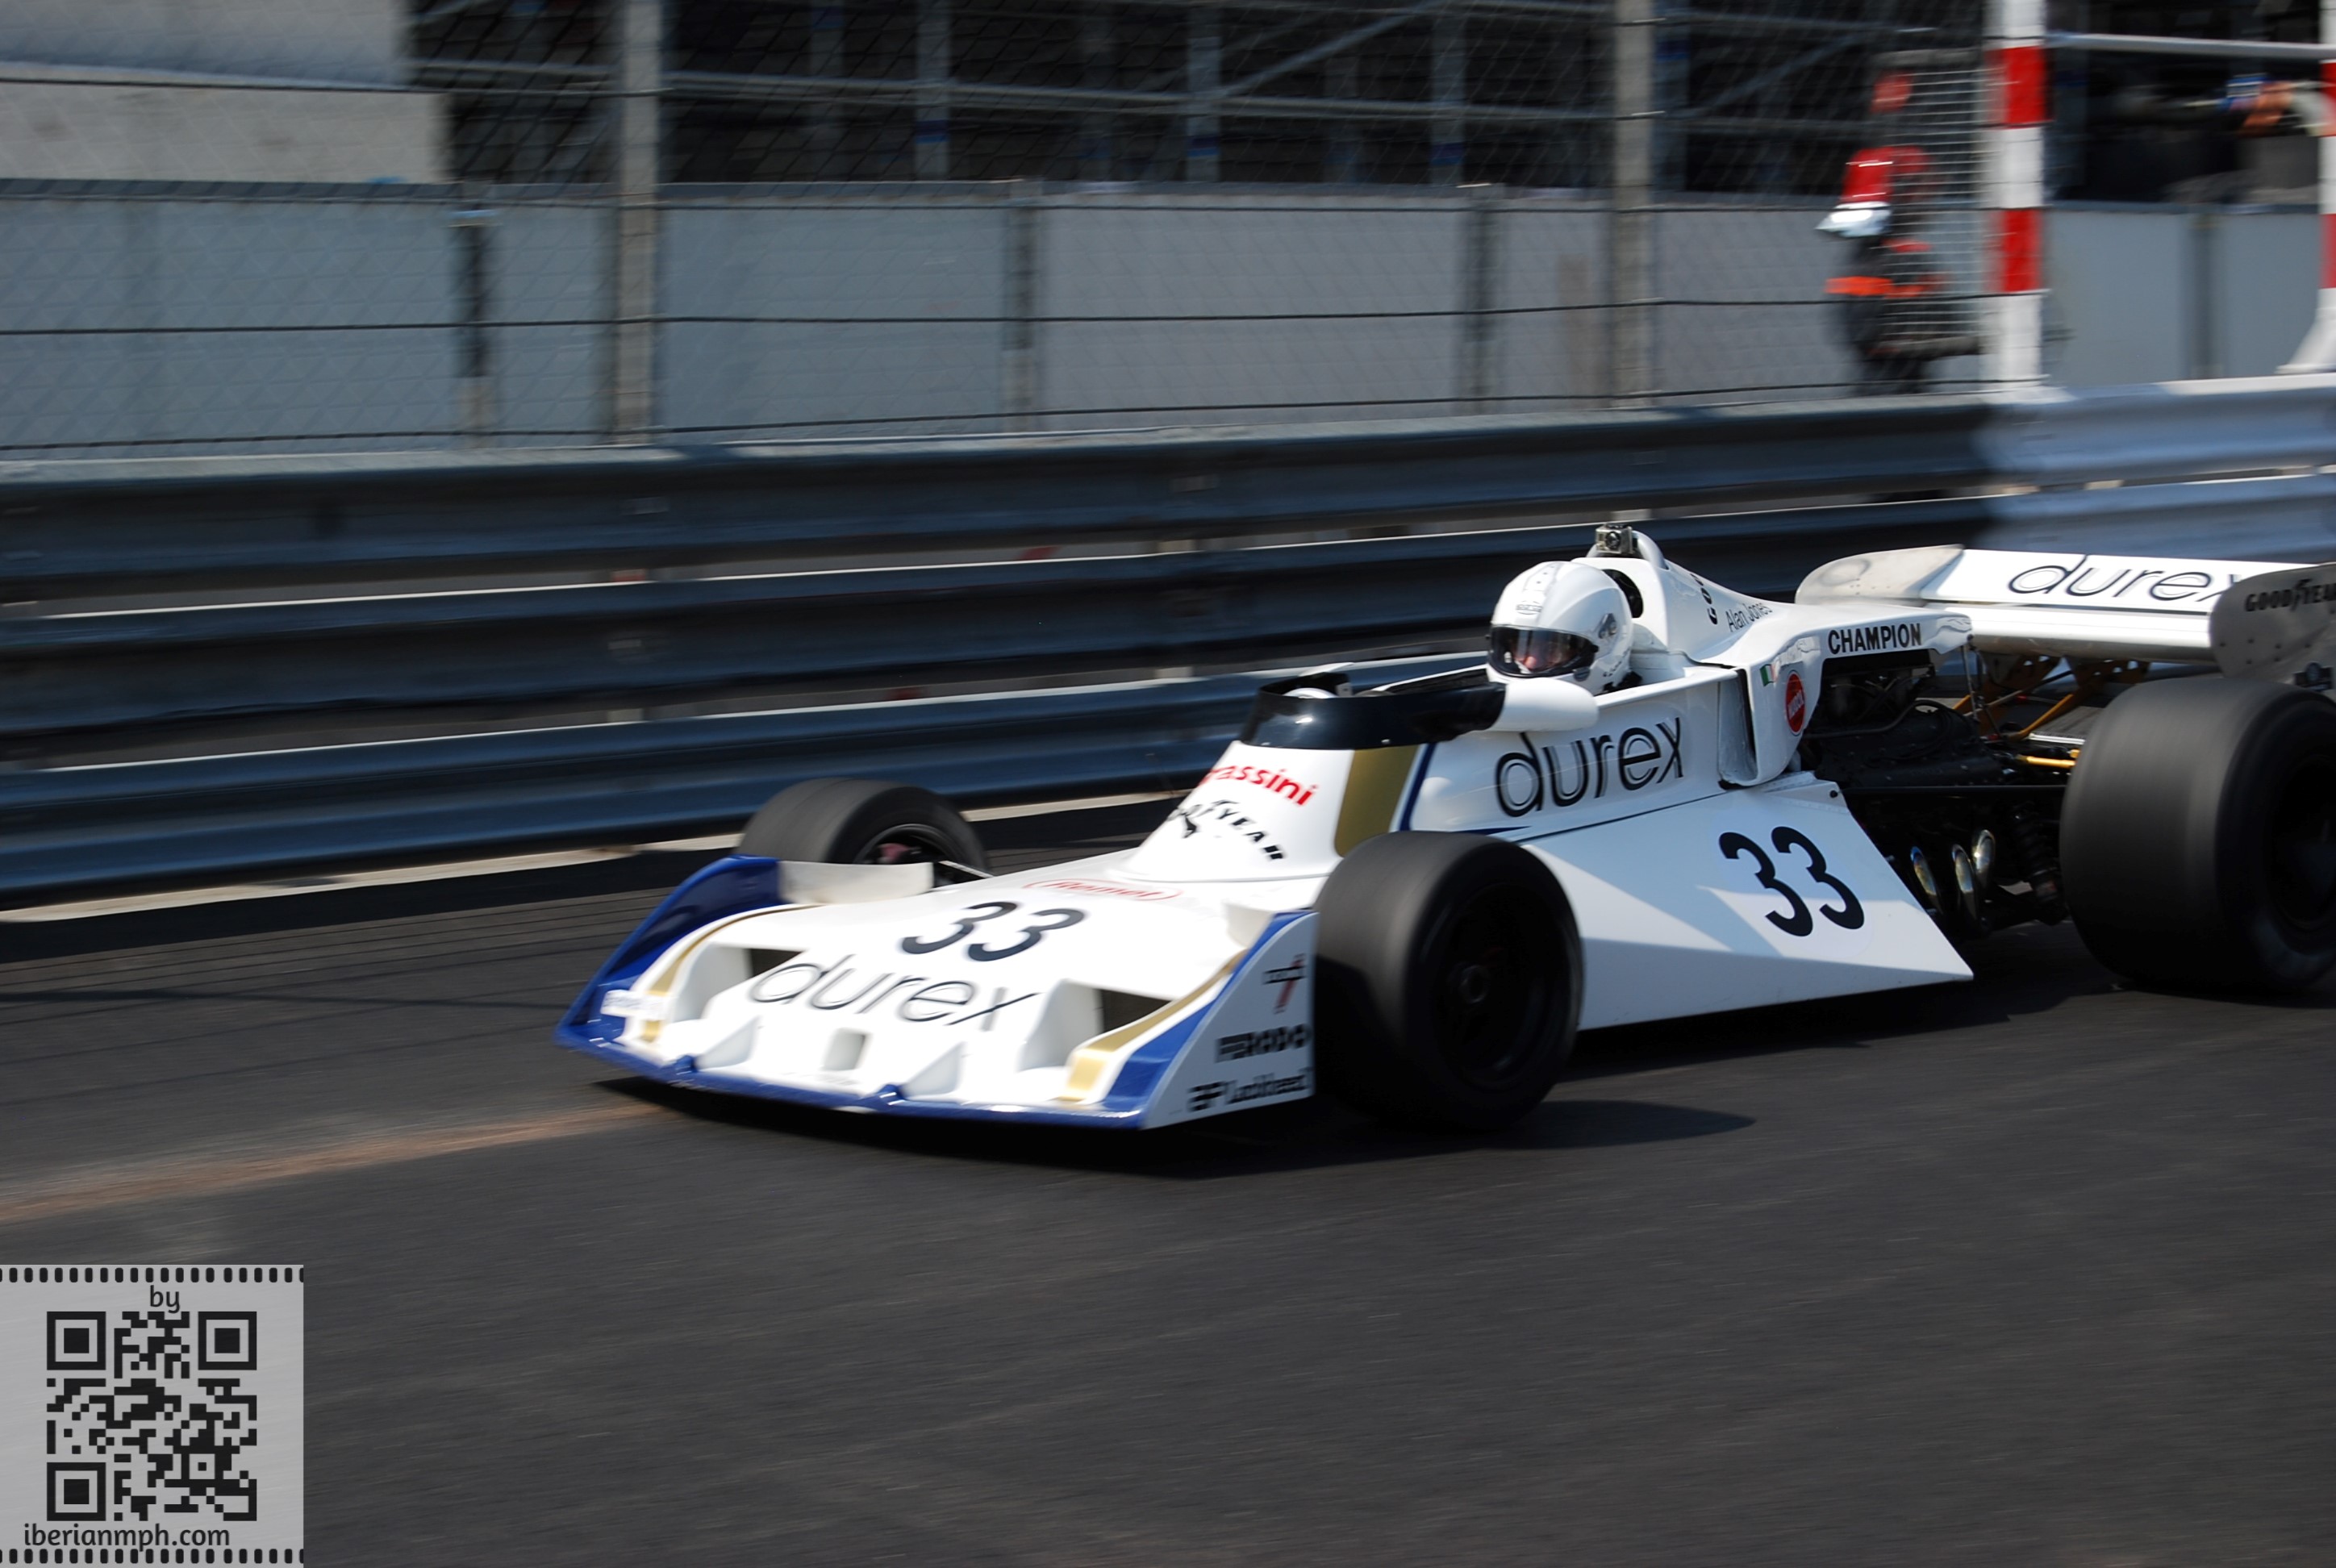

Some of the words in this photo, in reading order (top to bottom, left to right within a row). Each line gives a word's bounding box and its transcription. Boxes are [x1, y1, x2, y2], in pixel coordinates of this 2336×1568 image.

[1725, 608, 1750, 633] Alan
[1828, 623, 1921, 654] CHAMPION
[1495, 717, 1683, 818] durex
[1719, 826, 1864, 936] 33
[900, 901, 1084, 961] 33
[749, 954, 1041, 1032] durex
